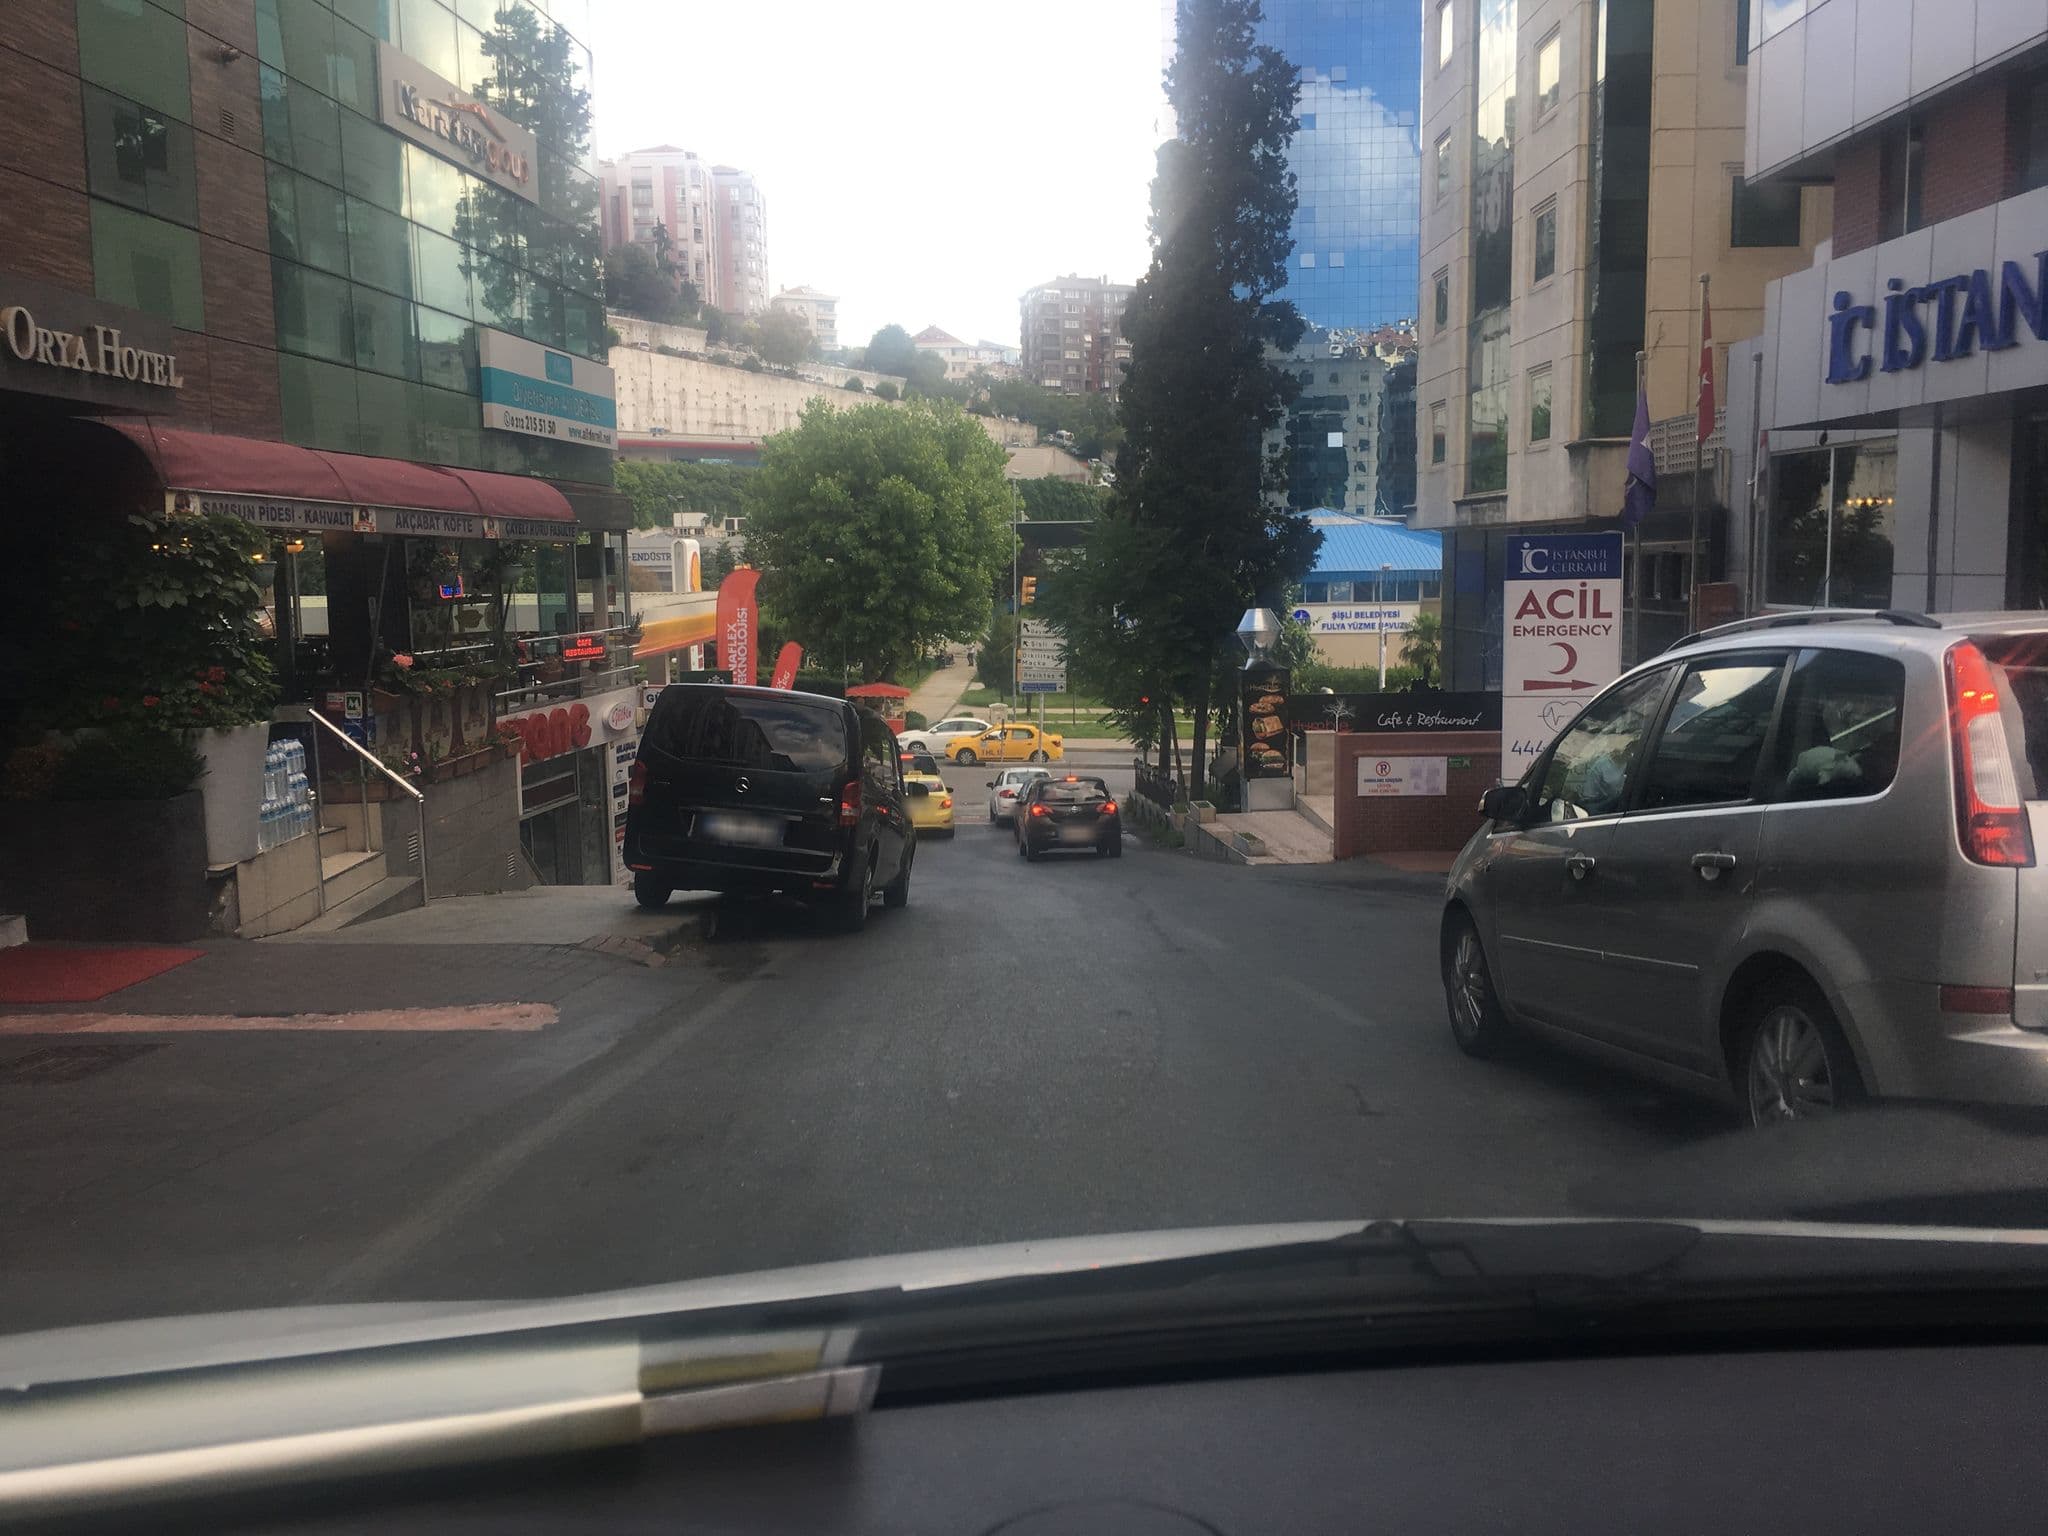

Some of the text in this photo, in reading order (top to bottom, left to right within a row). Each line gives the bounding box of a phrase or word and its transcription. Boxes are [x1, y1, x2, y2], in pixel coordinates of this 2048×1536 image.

[94, 325, 184, 388] HOTEL
[258, 504, 295, 523] PİDESİ
[396, 512, 441, 533] AKÇABAT
[1514, 581, 1613, 620] ACİL
[1331, 610, 1352, 620] ŞİŞLİ
[1321, 622, 1346, 630] FULYA
[1347, 621, 1376, 630] YÜZME
[1513, 624, 1613, 637] EMERGENCY
[1417, 710, 1482, 727] Restaurant
